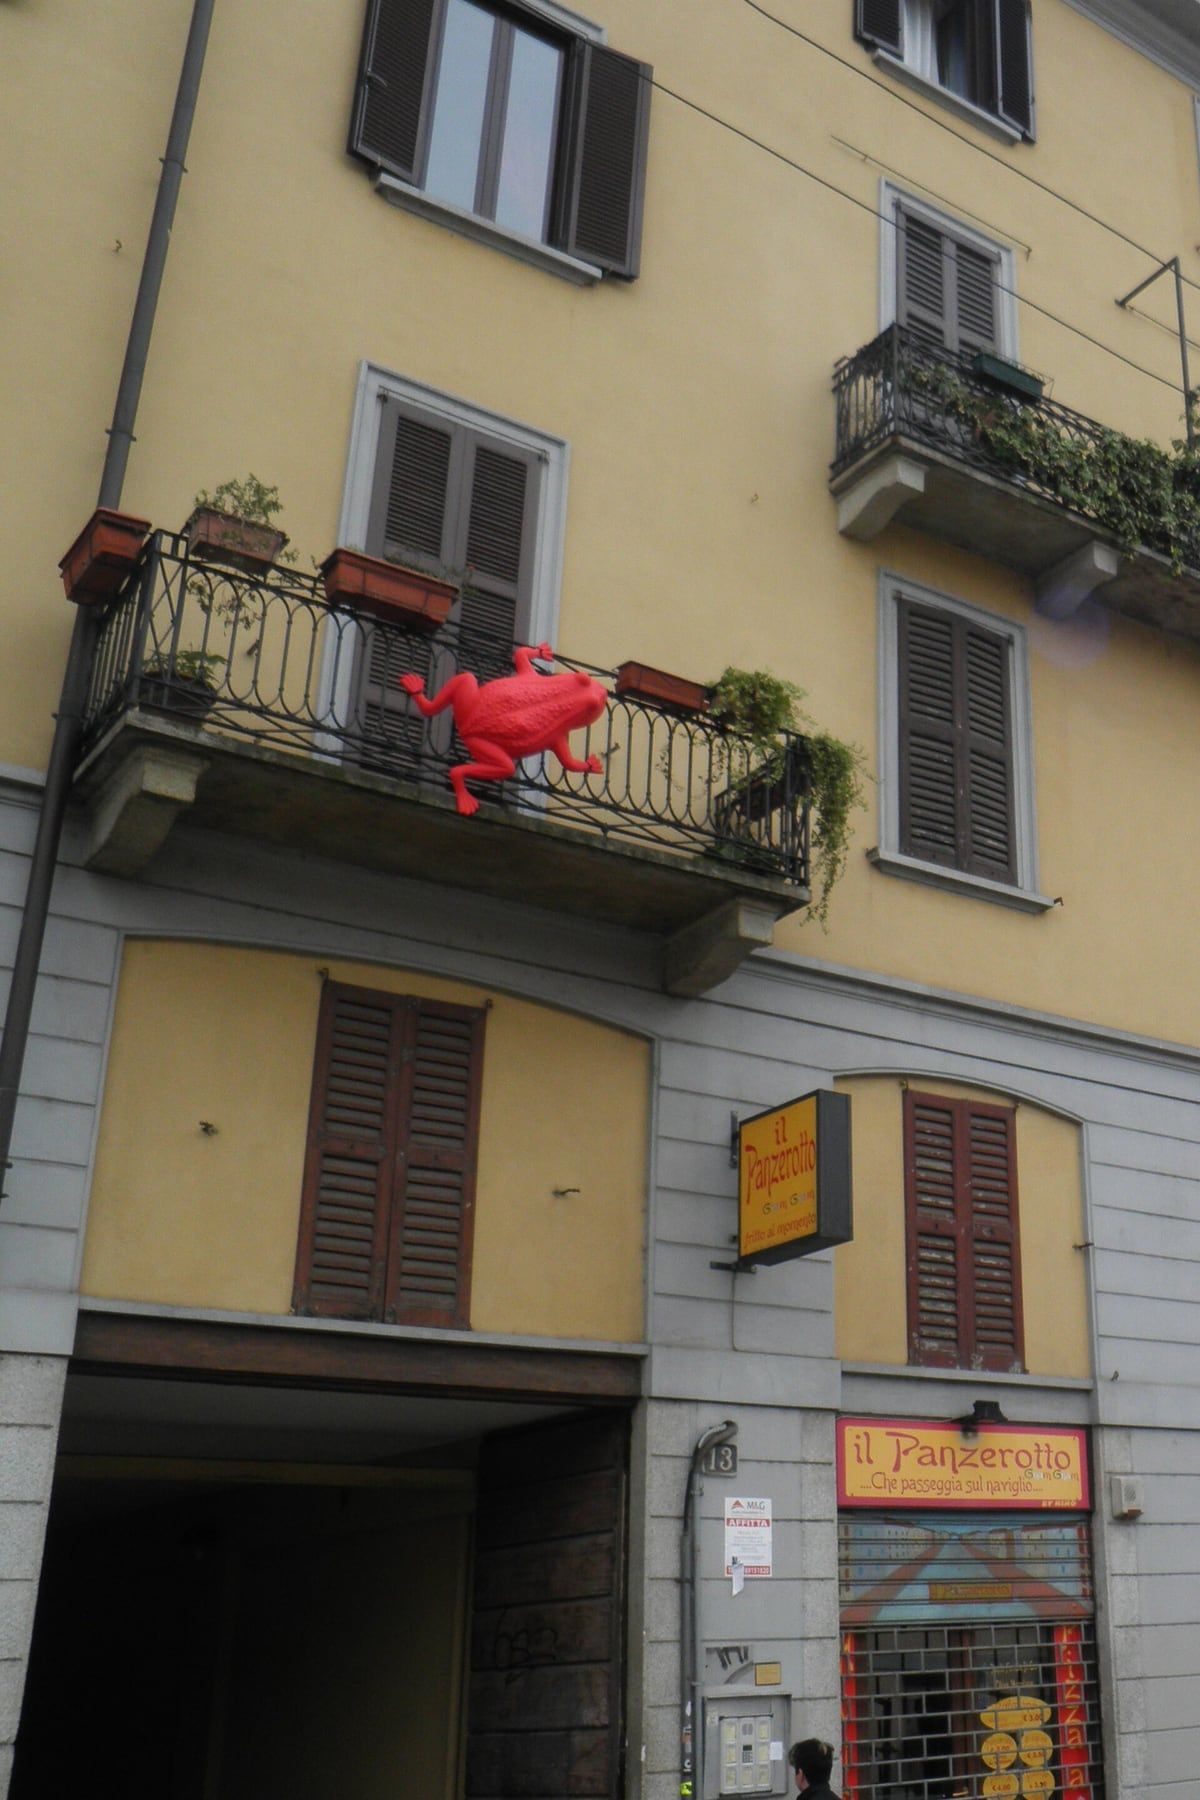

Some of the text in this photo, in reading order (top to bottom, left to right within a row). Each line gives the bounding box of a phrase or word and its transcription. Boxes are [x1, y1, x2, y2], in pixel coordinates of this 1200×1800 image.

[773, 1116, 788, 1146] il
[745, 1130, 816, 1205] Panzerotto
[709, 1446, 733, 1472] 13
[853, 1430, 1072, 1475] il Panzerotto
[900, 1473, 964, 1497] passeggia
[964, 1474, 984, 1495] sul
[728, 1518, 769, 1528] AFFITTA
